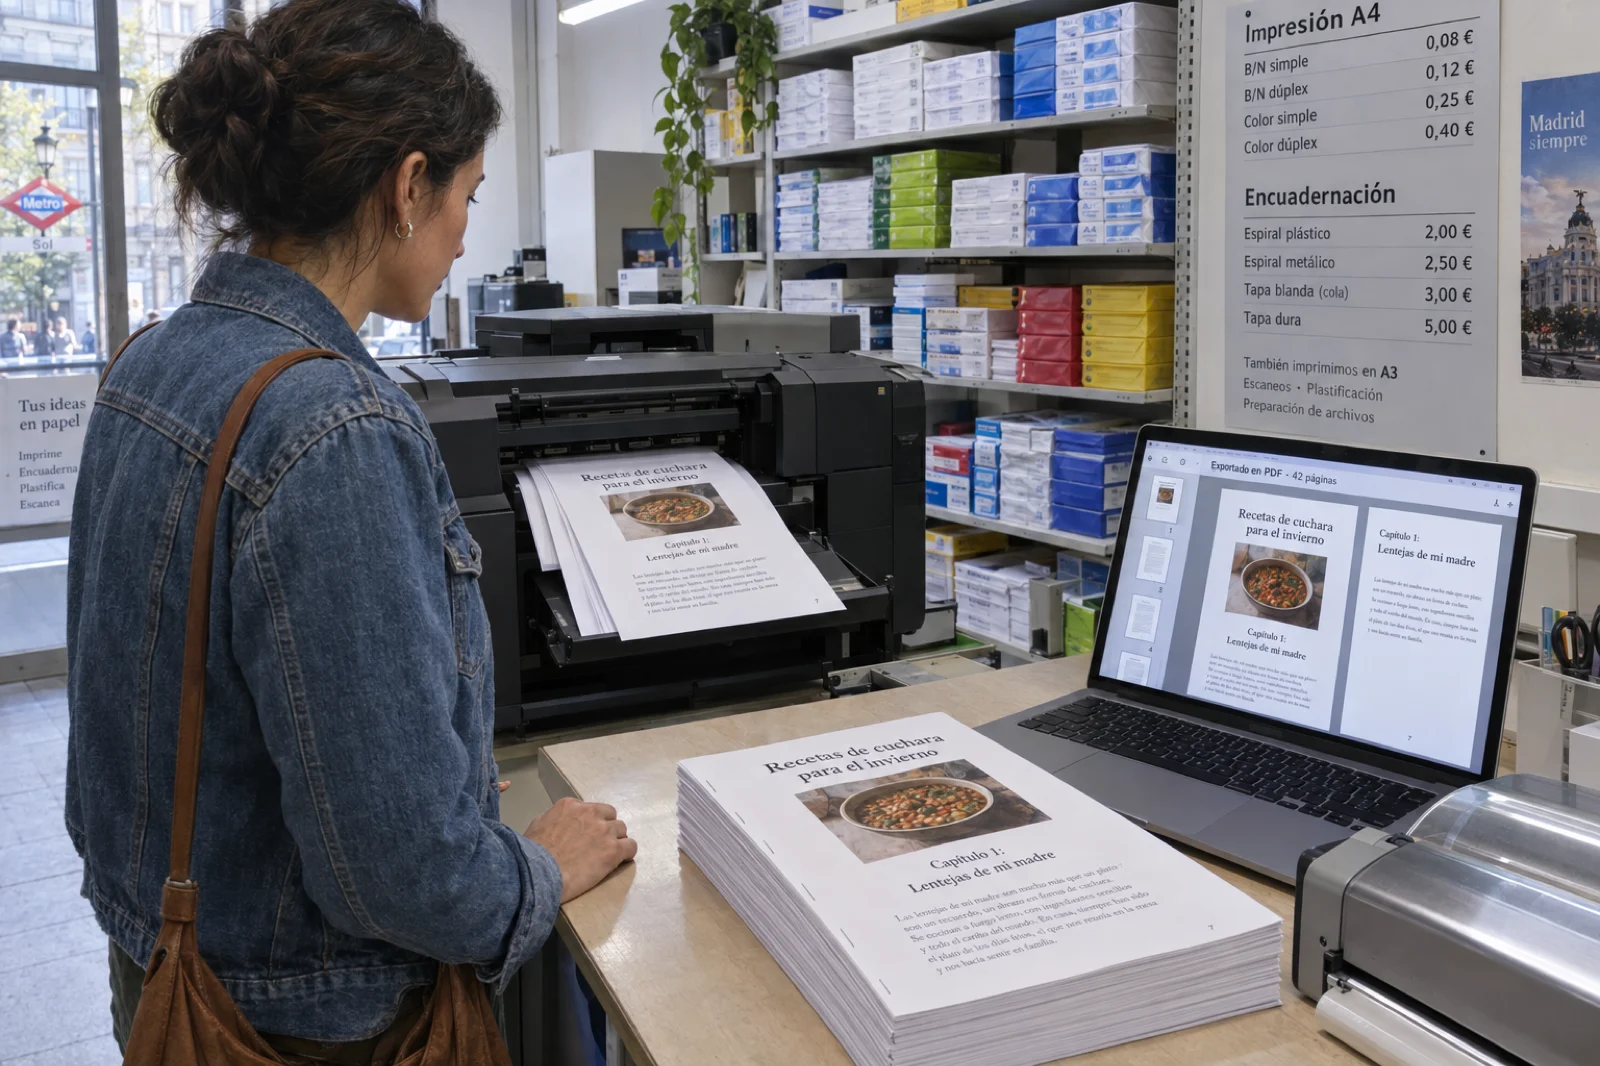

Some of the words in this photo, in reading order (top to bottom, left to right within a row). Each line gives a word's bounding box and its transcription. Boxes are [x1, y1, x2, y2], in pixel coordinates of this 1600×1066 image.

[1246, 9, 1343, 44] Impresión
[1351, 3, 1380, 26] A4
[1426, 32, 1458, 51] 0,08
[1464, 30, 1473, 44] €
[1245, 61, 1266, 76] B/N
[1270, 55, 1308, 73] simple
[1426, 62, 1459, 81] 0,12
[1465, 60, 1474, 75] €
[1245, 87, 1265, 102] B/N
[1269, 82, 1308, 100] dúplex
[1426, 92, 1459, 111] 0,25
[1465, 90, 1474, 105] €
[1245, 113, 1273, 128] Color
[1278, 109, 1317, 126] simple
[1529, 110, 1585, 132] Madrid
[1425, 123, 1459, 141] 0,40
[1465, 121, 1474, 136] €
[1245, 139, 1273, 154] Color
[1278, 137, 1317, 154] dúplex
[1529, 134, 1588, 152] siempre
[23, 197, 60, 209] Metro
[1246, 182, 1395, 207] Encuadernación
[1245, 226, 1281, 242] Espiral
[1286, 226, 1330, 242] plástico
[1425, 224, 1457, 242] 2,00
[1462, 224, 1472, 239] €
[33, 239, 53, 250] Sol
[1245, 255, 1281, 271] Espiral
[1286, 255, 1335, 269] metálico
[1425, 256, 1457, 273] 2,50
[1463, 256, 1472, 271] €
[1245, 283, 1270, 299] Tapa
[1276, 284, 1314, 298] blanda
[1319, 285, 1349, 301] (cola)
[1425, 287, 1457, 304] 3,00
[1463, 288, 1472, 303] €
[1244, 311, 1271, 328] Tapa
[1276, 312, 1301, 326] dura
[1425, 319, 1456, 336] 5,00
[1462, 320, 1472, 334] €
[1244, 356, 1288, 371] También
[1293, 360, 1357, 376] imprimimos
[1362, 368, 1376, 378] en
[1381, 366, 1397, 379] A3
[1244, 378, 1291, 392] Escaneos
[1307, 382, 1383, 401] Plastificación
[18, 399, 45, 412] Tus
[50, 398, 86, 411] ideas
[1244, 398, 1304, 415] Preparación
[1308, 404, 1322, 417] de
[1326, 407, 1374, 424] archivos
[20, 420, 36, 430] en
[42, 414, 80, 433] papel
[19, 450, 62, 462] Imprime
[19, 464, 78, 477] Encuaderna
[581, 471, 631, 482] Recetas
[634, 469, 650, 477] de
[653, 463, 707, 474] cuchara
[1211, 460, 1249, 475] Exportado
[1264, 467, 1282, 478] PDF
[1292, 471, 1303, 481] 42
[1305, 473, 1337, 485] páginas
[20, 481, 65, 493] Plastifica
[602, 482, 630, 491] para
[648, 474, 699, 484] invierno
[1238, 508, 1275, 522] Recetas
[1278, 514, 1290, 525] de
[1293, 518, 1333, 532] cuchara
[1246, 526, 1268, 536] para
[1271, 528, 1280, 538] el
[1282, 529, 1324, 545] invierno
[1378, 543, 1414, 558] Lentejas
[1417, 550, 1428, 559] de
[1430, 553, 1443, 562] mi
[1446, 556, 1475, 567] madre
[1248, 628, 1278, 640] Capítulo
[1227, 636, 1257, 650] Lentejas
[1259, 643, 1269, 652] de
[1282, 651, 1306, 660] madre
[764, 749, 844, 774] Recetas
[847, 746, 870, 758] de
[874, 734, 945, 753] cuchara
[797, 764, 843, 784] para
[846, 759, 864, 772] el
[864, 748, 939, 769] invierno
[930, 851, 989, 870] Capítulo
[989, 847, 1005, 856] 1:
[907, 872, 972, 894] Lentejas
[973, 866, 992, 877] de
[993, 860, 1012, 873] mi
[1013, 850, 1056, 867] madre
